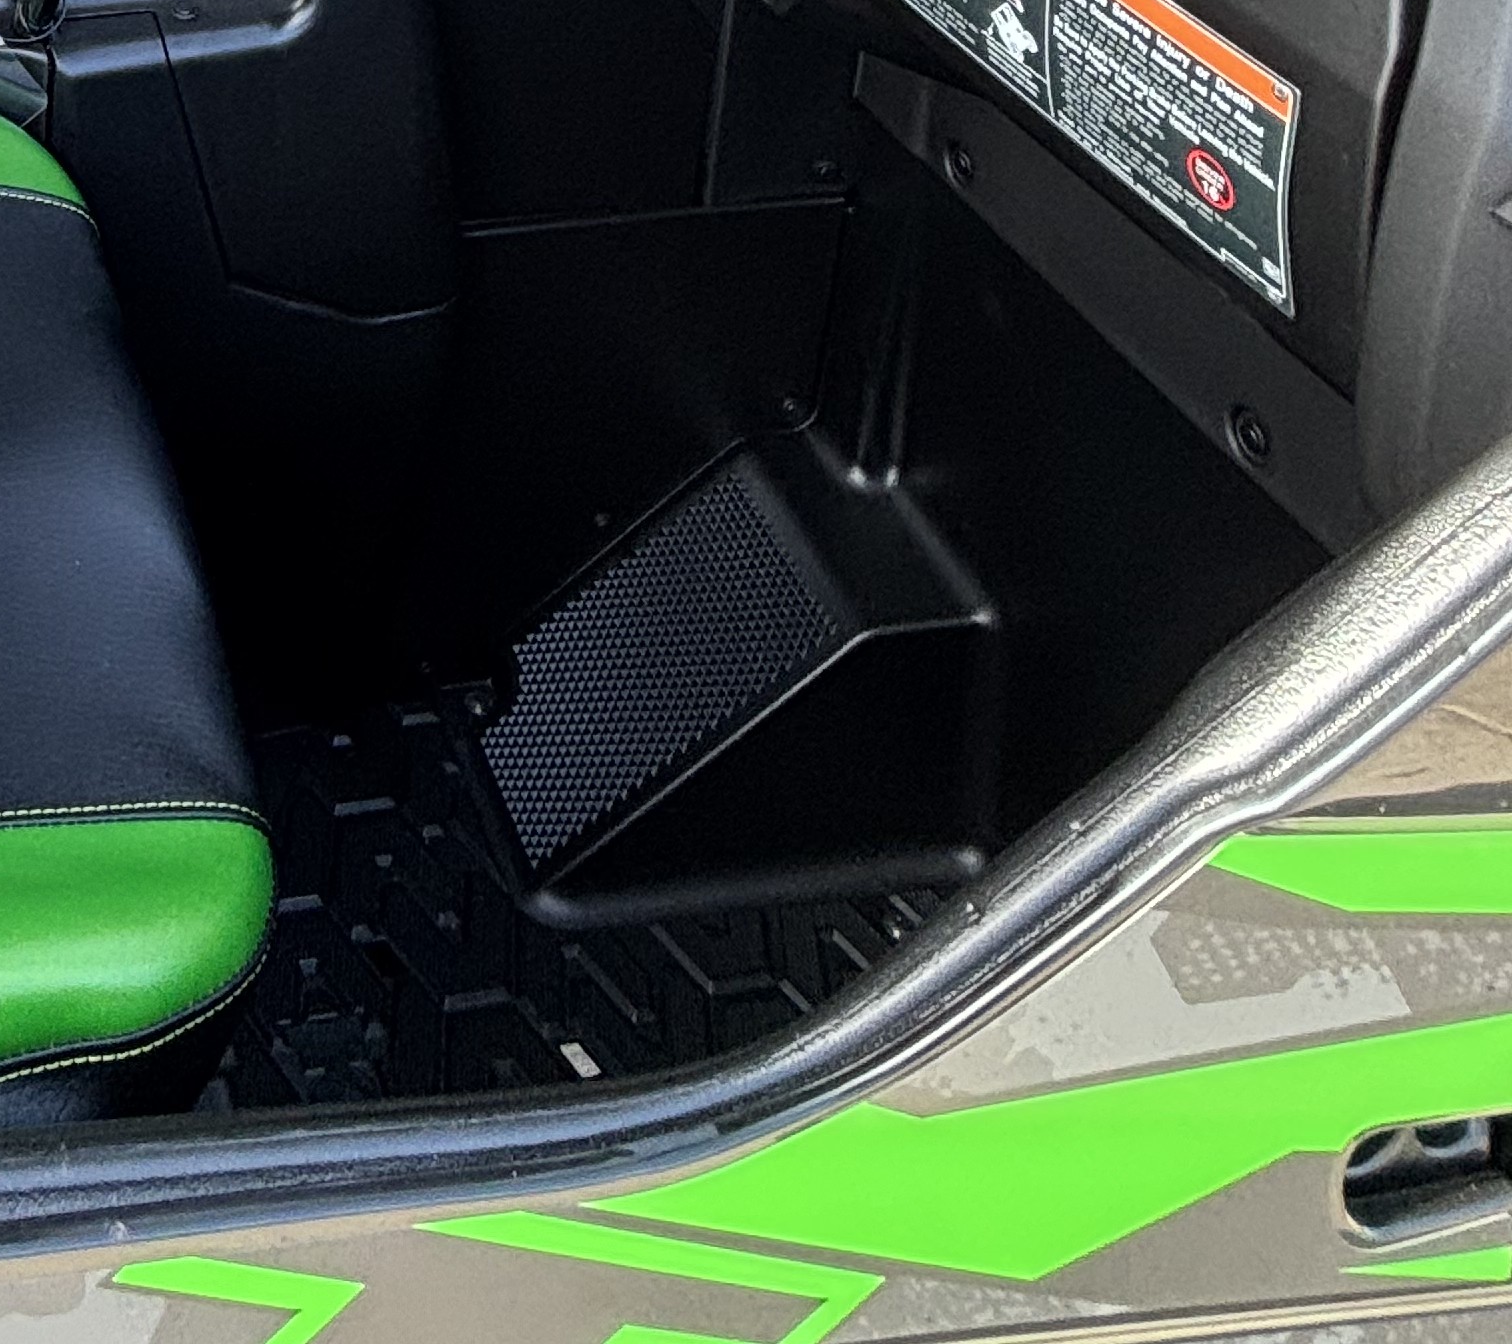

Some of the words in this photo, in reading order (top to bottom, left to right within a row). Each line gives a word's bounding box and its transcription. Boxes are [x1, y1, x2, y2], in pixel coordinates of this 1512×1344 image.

[1112, 2, 1151, 40] Severe
[1156, 34, 1191, 69] Injury
[1195, 65, 1211, 81] or
[1215, 76, 1254, 113] Death
